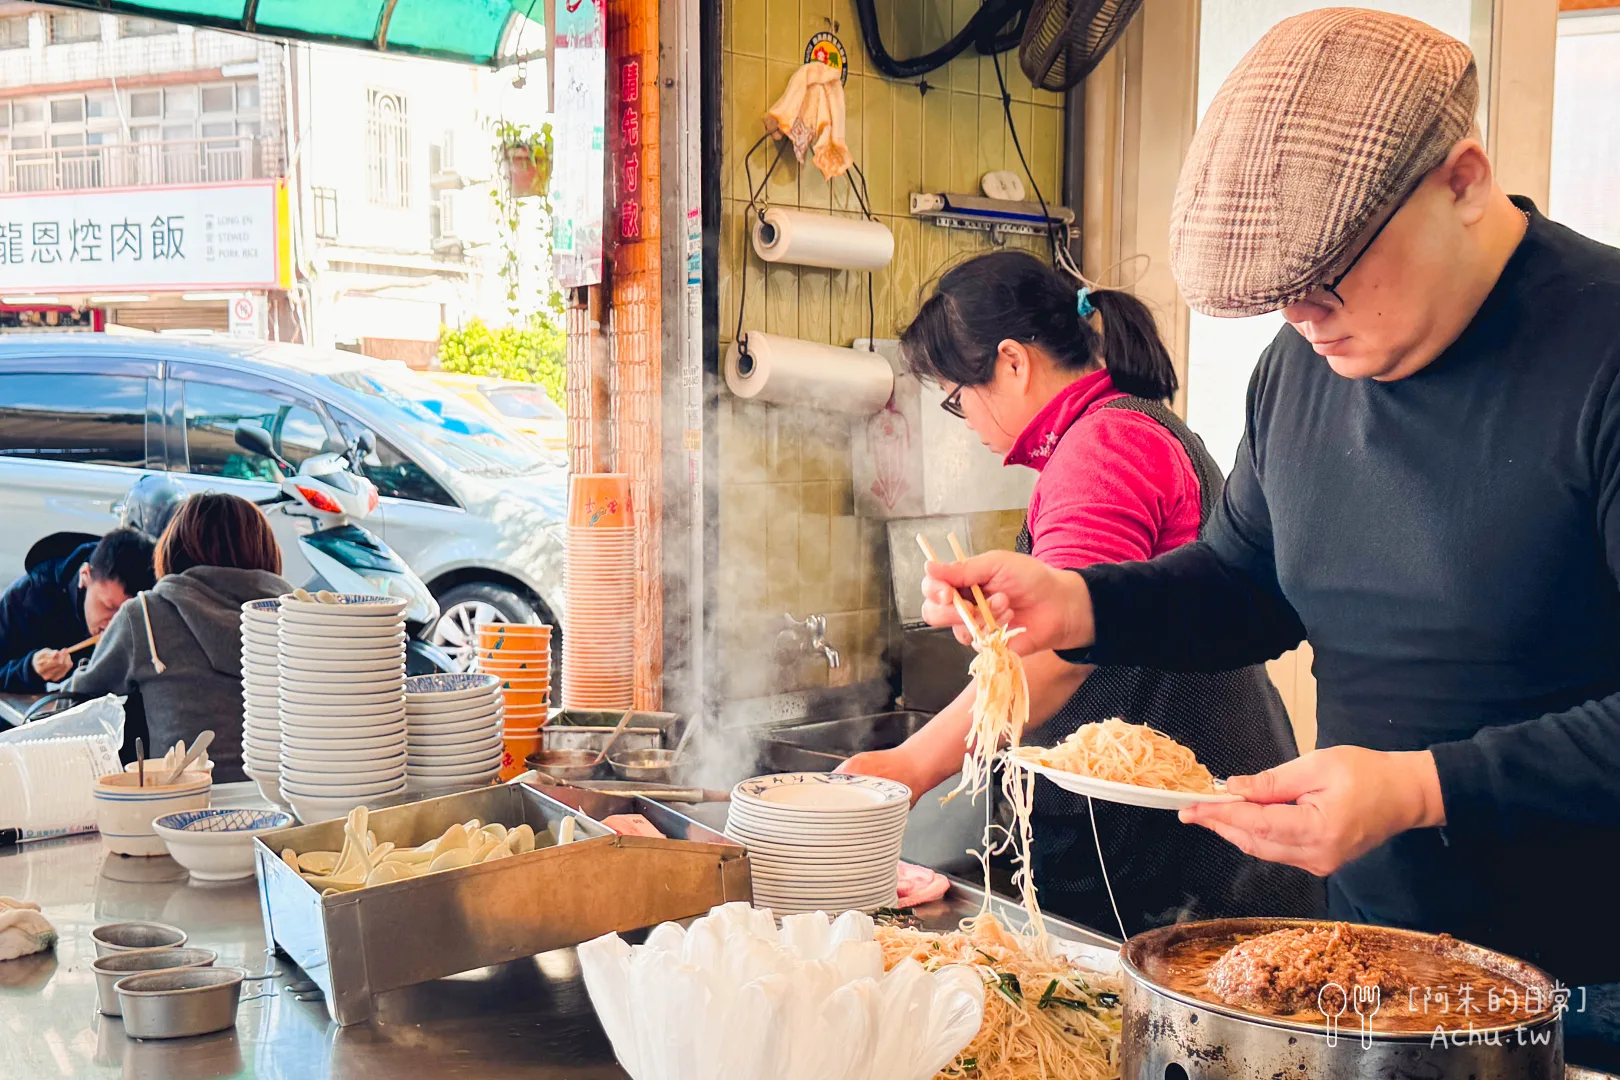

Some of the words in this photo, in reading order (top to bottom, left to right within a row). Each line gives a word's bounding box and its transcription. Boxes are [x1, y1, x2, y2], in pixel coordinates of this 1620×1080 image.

[621, 61, 640, 238] 請先付款
[217, 215, 240, 226] LONG
[242, 215, 253, 225] EN
[0, 215, 186, 265] 龍恩焢肉飯
[217, 232, 250, 243] STEWED
[218, 248, 241, 259] PORK
[242, 247, 258, 258] RICE
